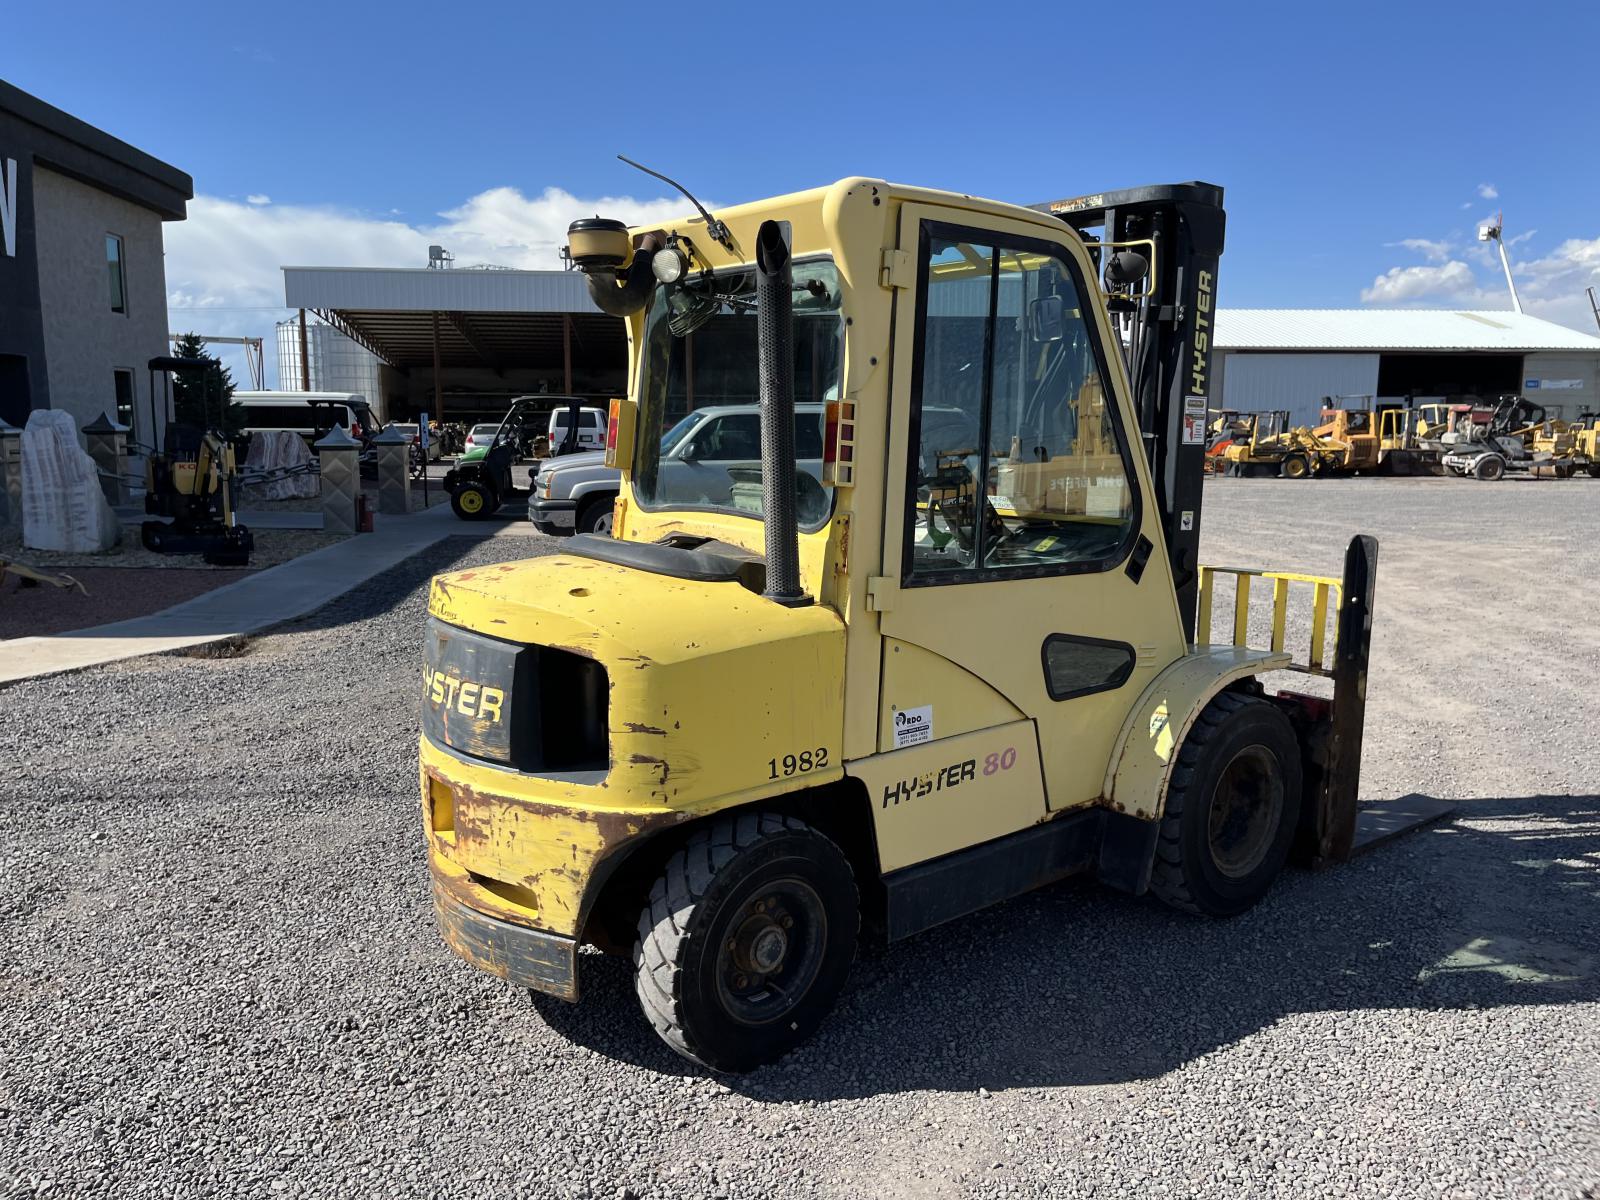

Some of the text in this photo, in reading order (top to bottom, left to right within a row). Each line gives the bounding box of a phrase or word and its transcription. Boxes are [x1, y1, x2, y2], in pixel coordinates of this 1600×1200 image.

[1191, 270, 1211, 395] HYSTER
[423, 662, 504, 722] YSTER
[768, 747, 829, 779] 1982
[882, 747, 1017, 809] HYSTER 80
